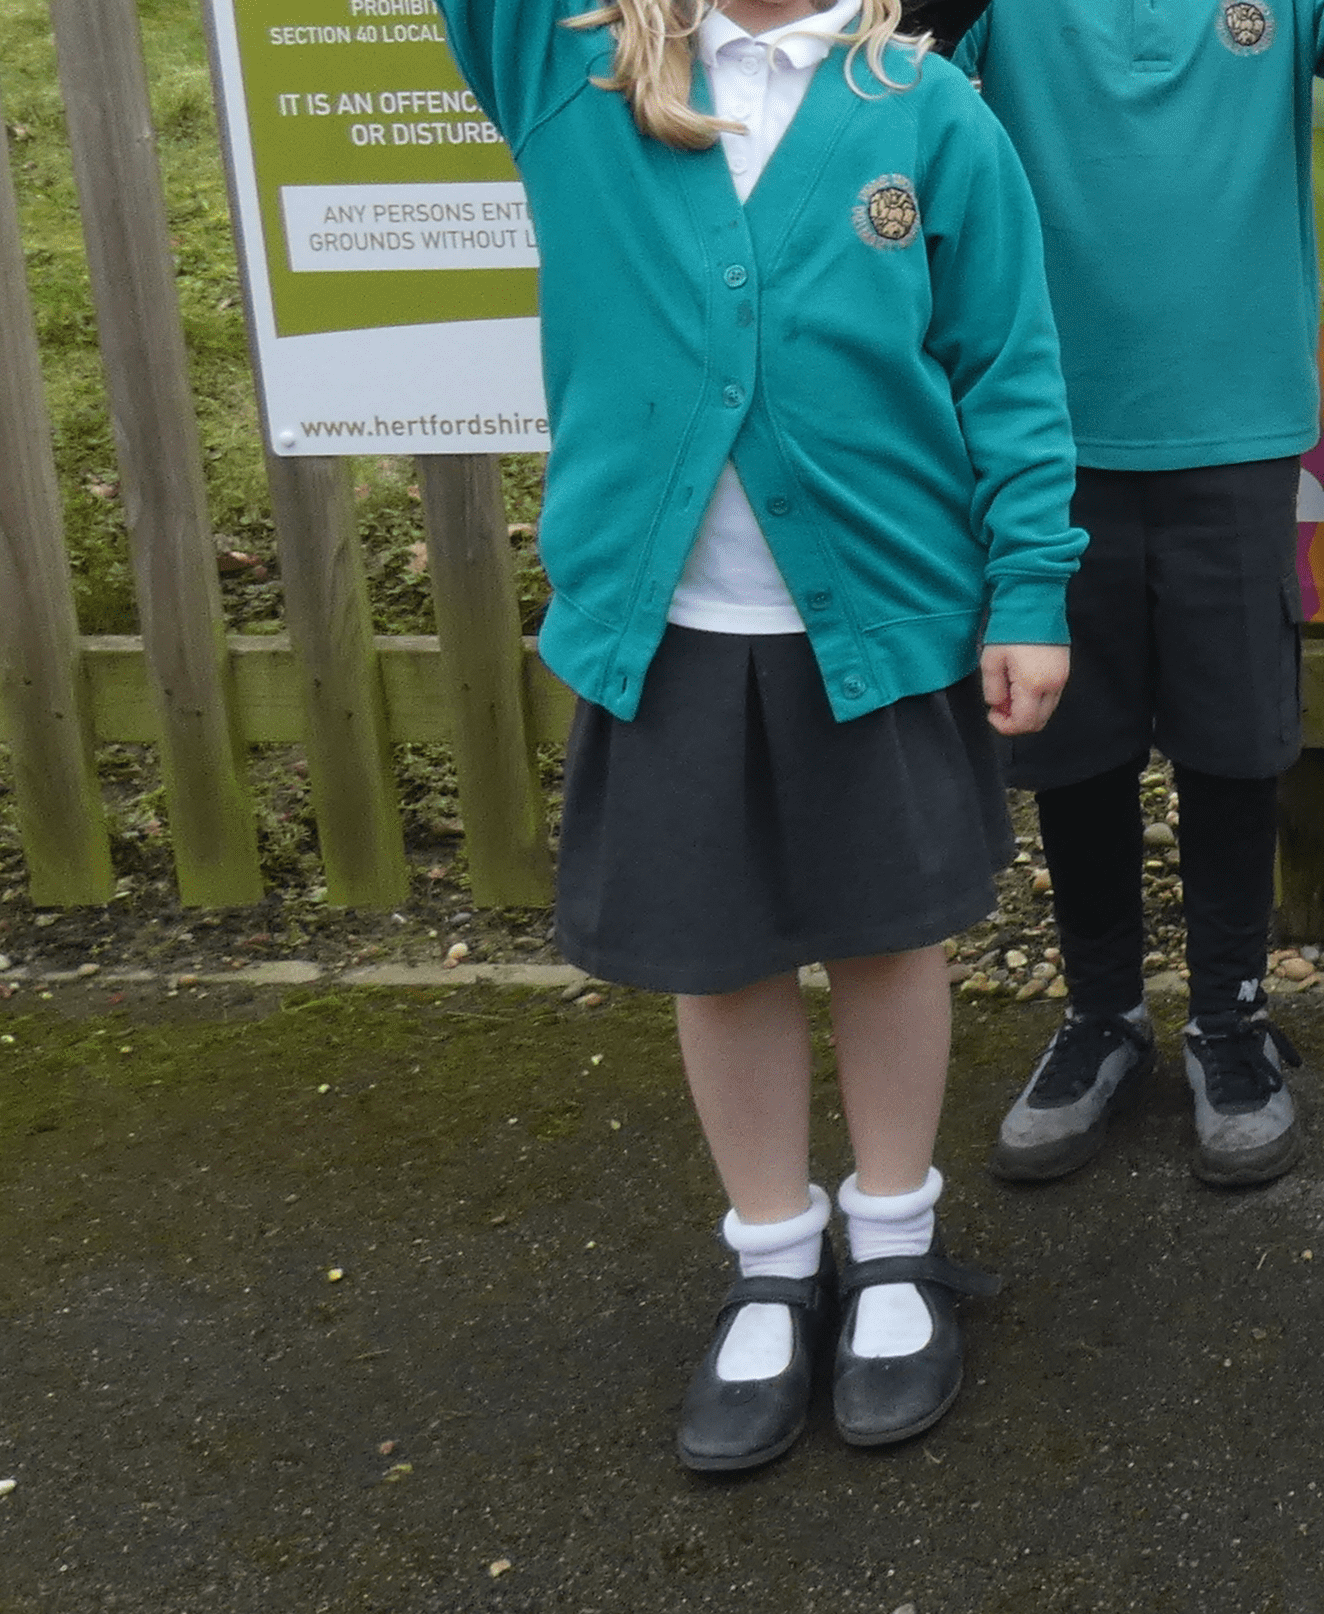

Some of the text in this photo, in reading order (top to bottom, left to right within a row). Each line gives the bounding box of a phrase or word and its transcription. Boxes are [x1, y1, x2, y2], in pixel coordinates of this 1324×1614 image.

[270, 23, 445, 44] SECTION 40 LOCAL
[280, 90, 481, 116] IT IS AN OFFENC
[352, 121, 504, 145] OR DISTURB
[324, 202, 533, 224] ANY PERSONS ENT
[309, 232, 415, 251] GROUNDS
[421, 230, 517, 250] WITHOUT
[301, 412, 549, 437] www.hertfordshire
